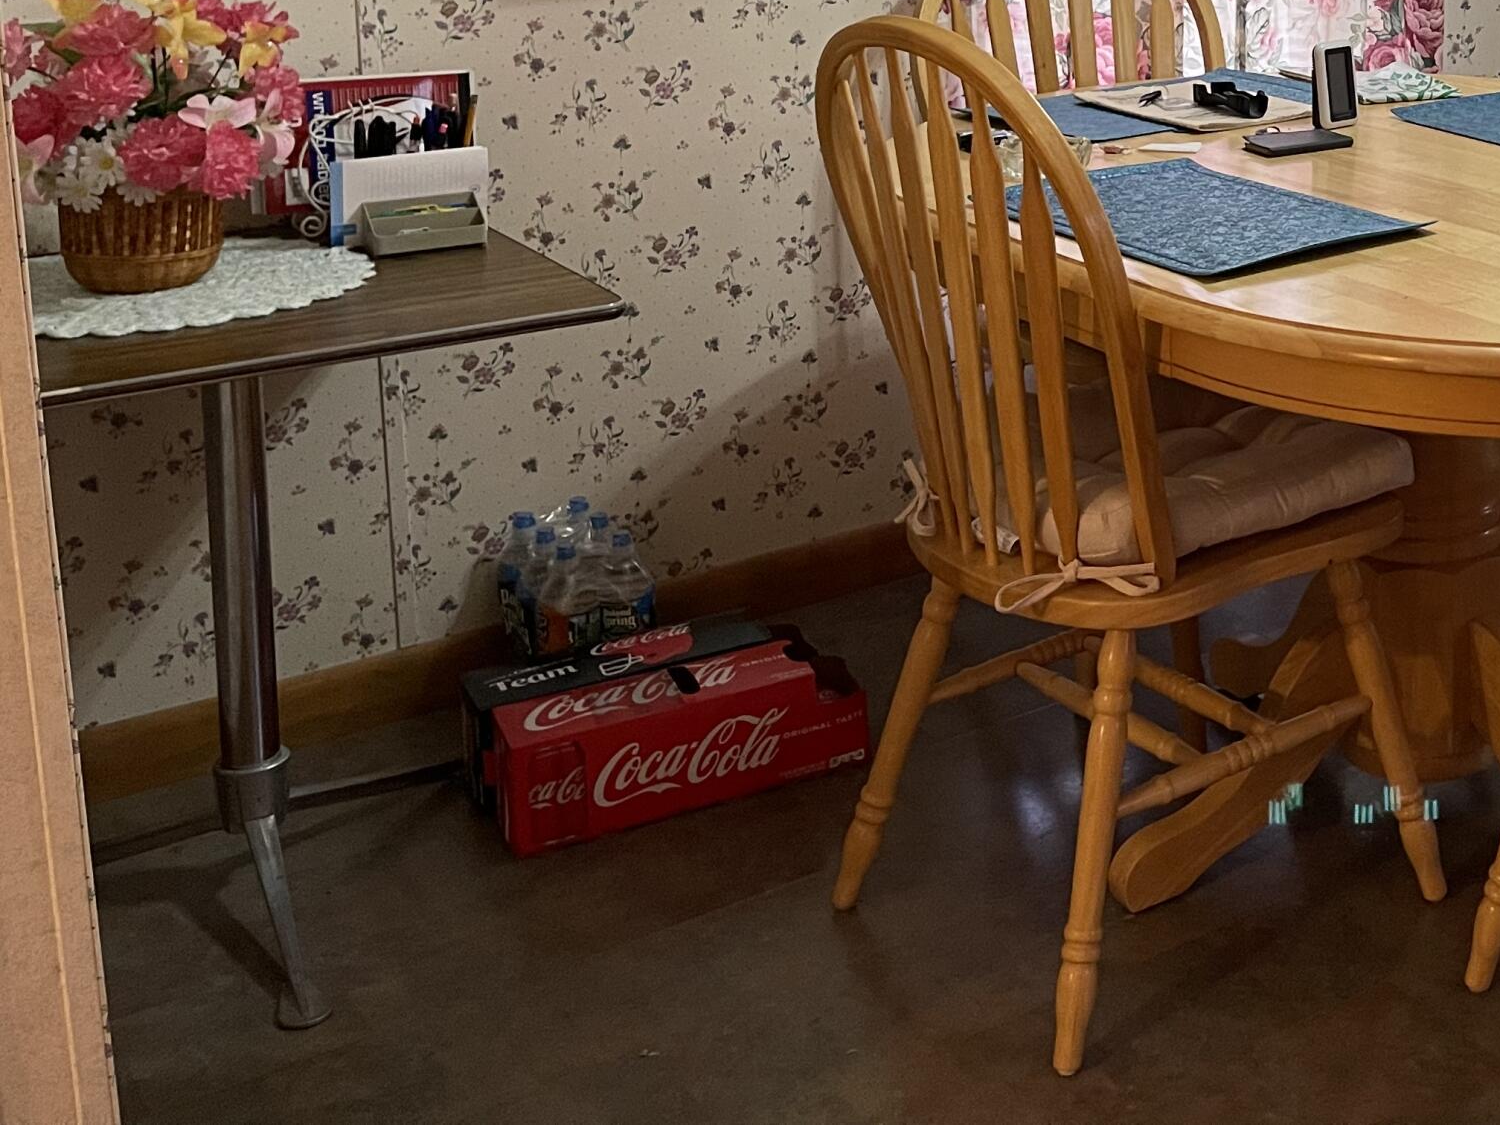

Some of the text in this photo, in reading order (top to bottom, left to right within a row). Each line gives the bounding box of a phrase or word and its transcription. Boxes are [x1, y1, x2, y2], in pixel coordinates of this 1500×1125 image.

[488, 664, 579, 692] Team
[783, 710, 865, 740] ORIGINAL TASTE
[593, 707, 789, 808] Coca-Cola
